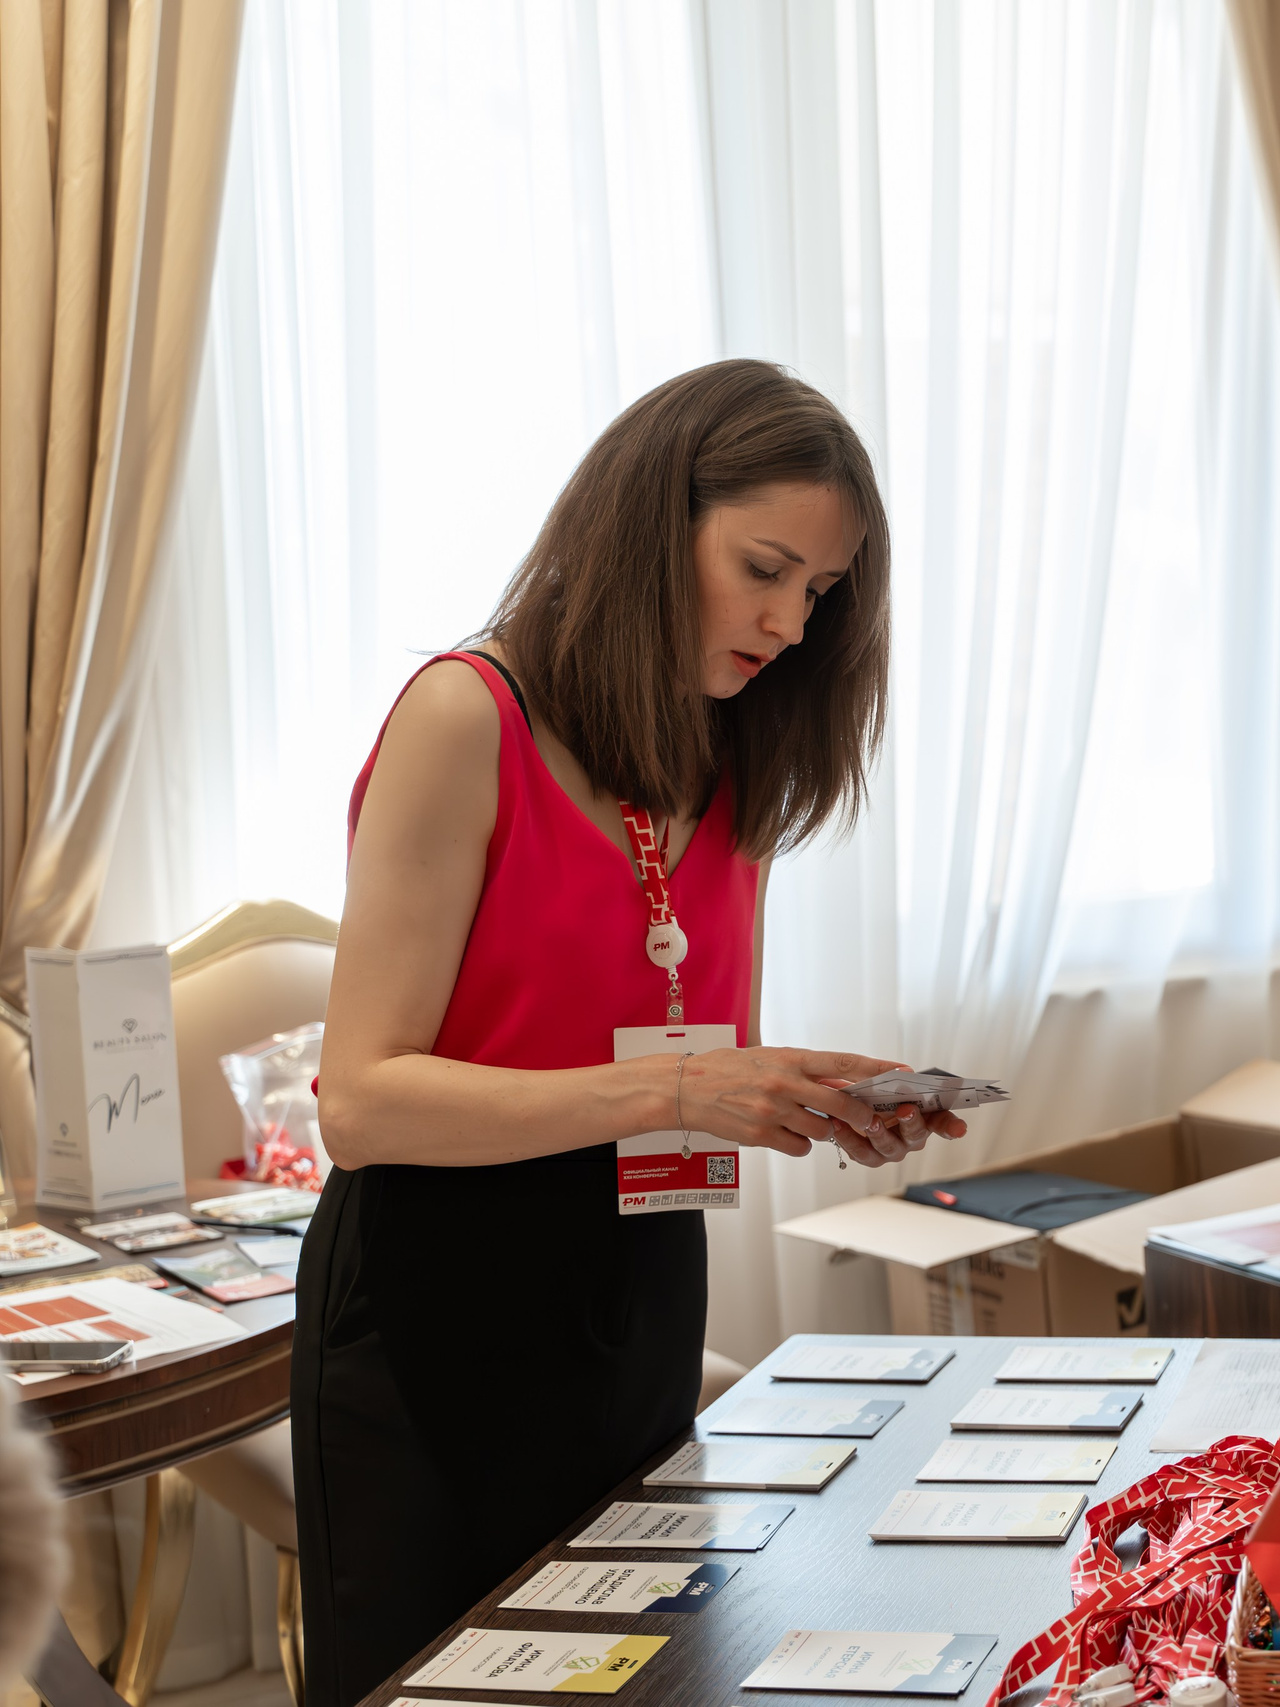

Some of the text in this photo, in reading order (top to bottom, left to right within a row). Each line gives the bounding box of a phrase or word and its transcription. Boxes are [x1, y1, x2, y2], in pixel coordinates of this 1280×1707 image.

[623, 1167, 662, 1175] ОФИЦИАЛЬНЫЙ
[659, 1514, 689, 1538] МИХАИЛ
[957, 1504, 981, 1526] МИХАИЛ
[574, 1568, 620, 1605] УЛЬЯЩЕНКО
[591, 1568, 635, 1605] ВЛАДИСЛАВ
[485, 1642, 533, 1679] ФИЛАТОВА
[511, 1649, 545, 1673] ИРИНА
[824, 1645, 861, 1678] ЕТЕРСКАЯ
[846, 1651, 875, 1674] ИРИНА
